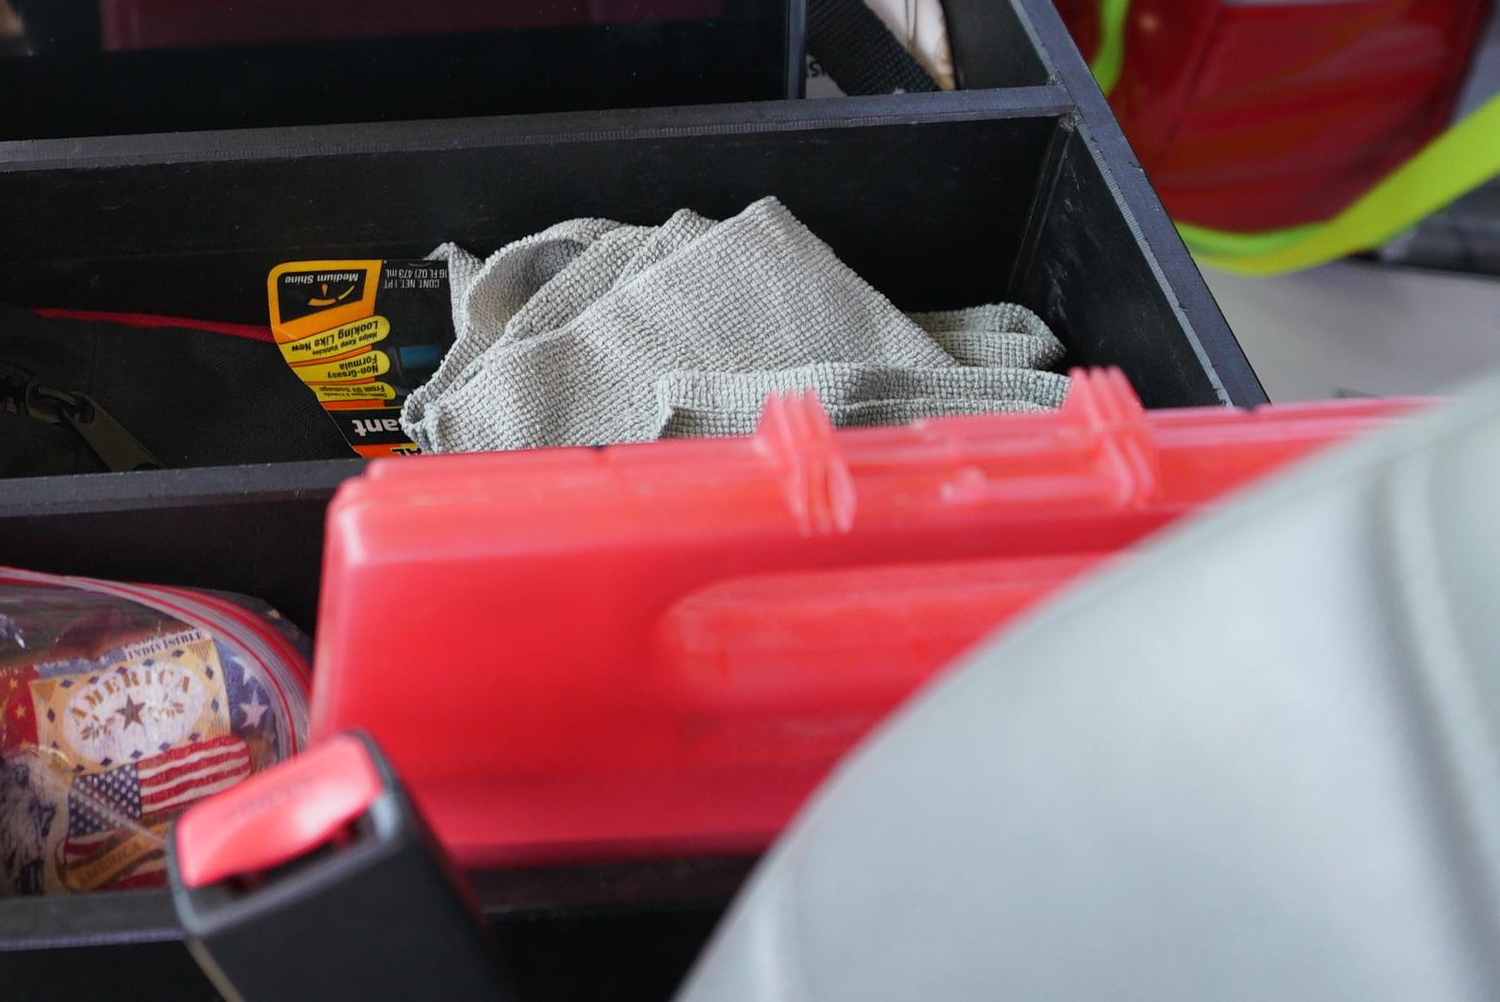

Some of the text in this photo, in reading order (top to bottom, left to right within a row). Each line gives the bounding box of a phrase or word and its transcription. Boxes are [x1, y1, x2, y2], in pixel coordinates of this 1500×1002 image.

[284, 272, 359, 285] Medium Shine
[398, 268, 414, 279] 473
[429, 268, 438, 279] FL
[384, 279, 394, 289] PT
[291, 320, 379, 352] Looking Like New
[341, 339, 357, 349] Keep
[339, 354, 378, 370] Formula
[327, 364, 379, 379] Non-Greasy
[364, 384, 386, 393] From
[351, 419, 400, 437] ant
[127, 631, 205, 660] INDIVISIBLE
[70, 668, 191, 721] AMERICA
